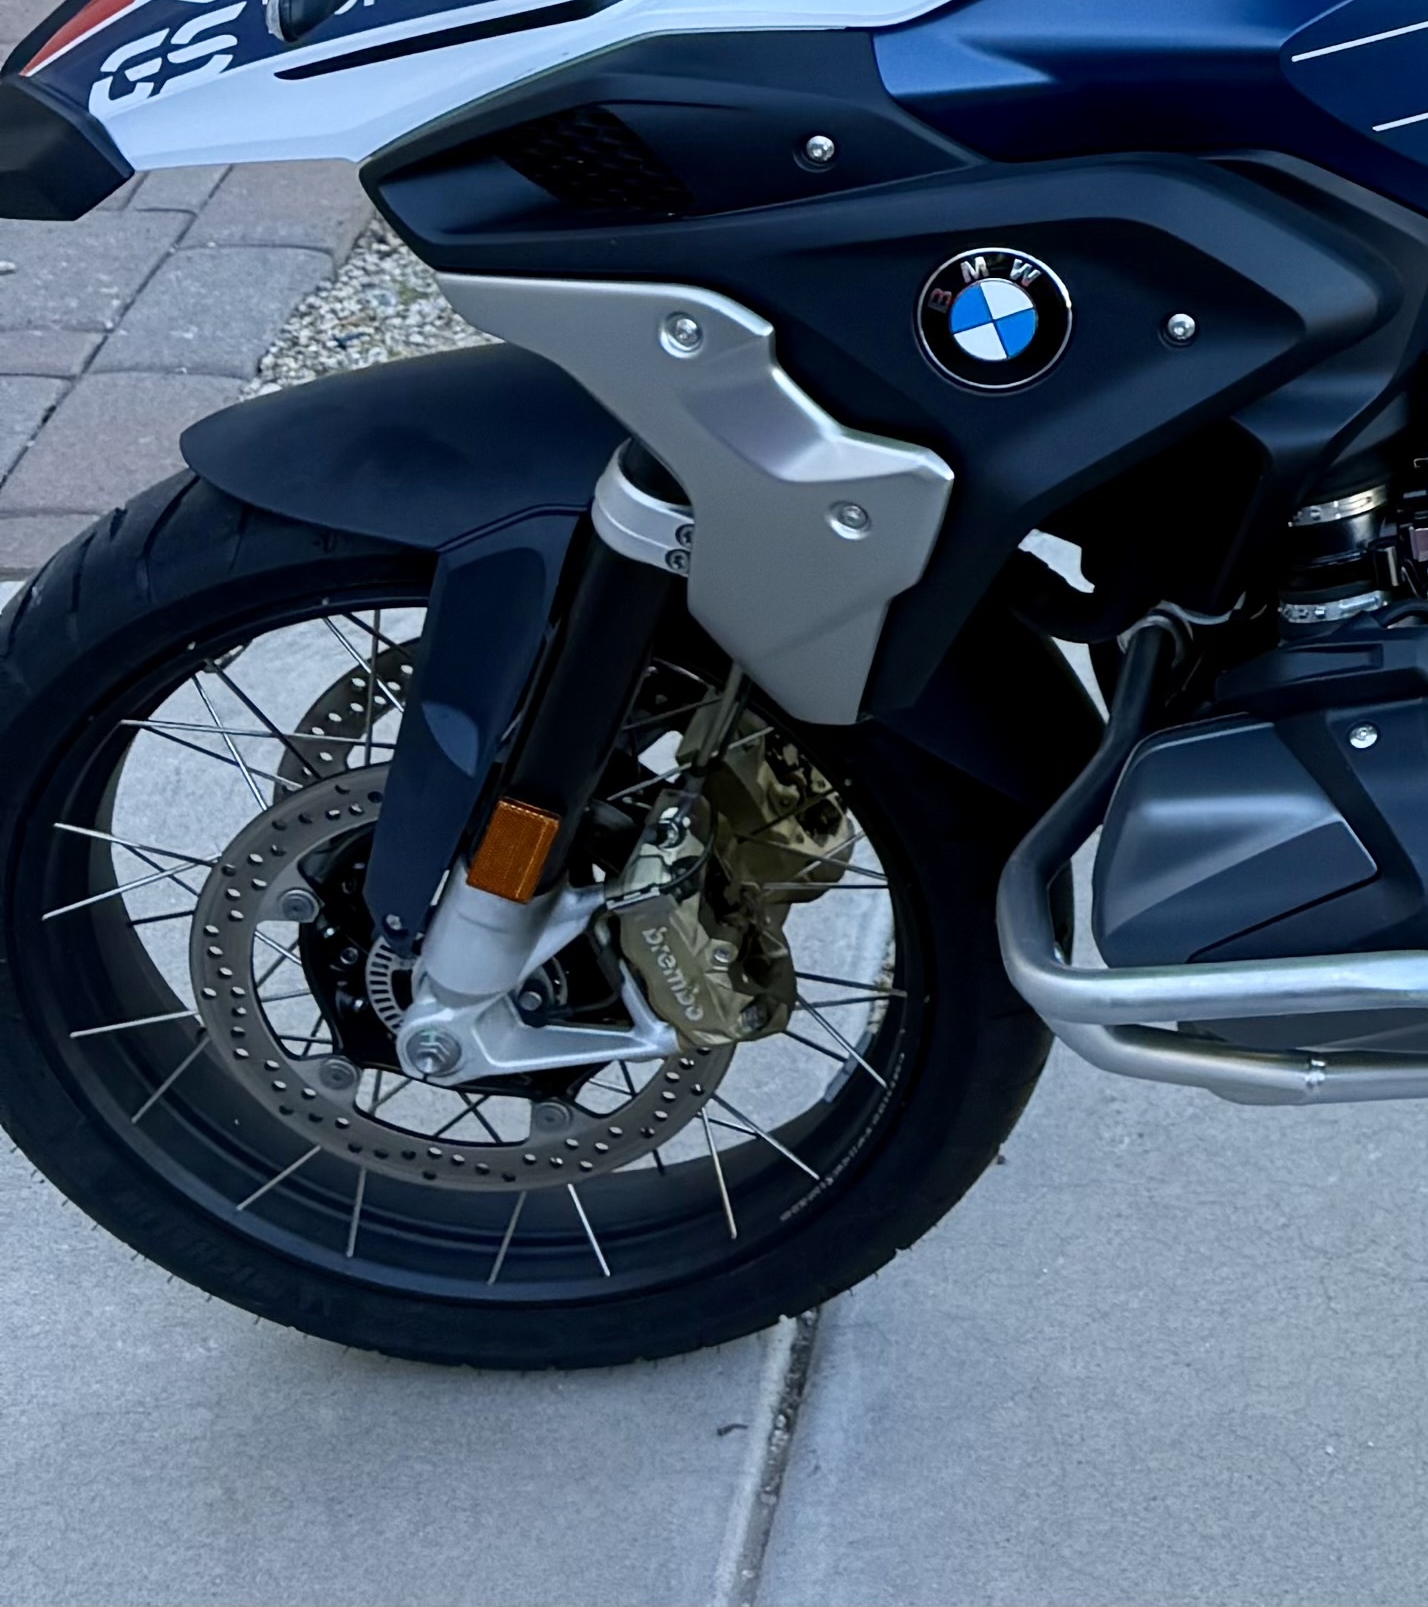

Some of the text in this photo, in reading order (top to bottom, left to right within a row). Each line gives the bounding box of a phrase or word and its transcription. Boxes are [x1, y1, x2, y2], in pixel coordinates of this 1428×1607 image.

[88, 0, 248, 115] GS
[928, 255, 1042, 313] BMW
[641, 926, 705, 1022] brembo
